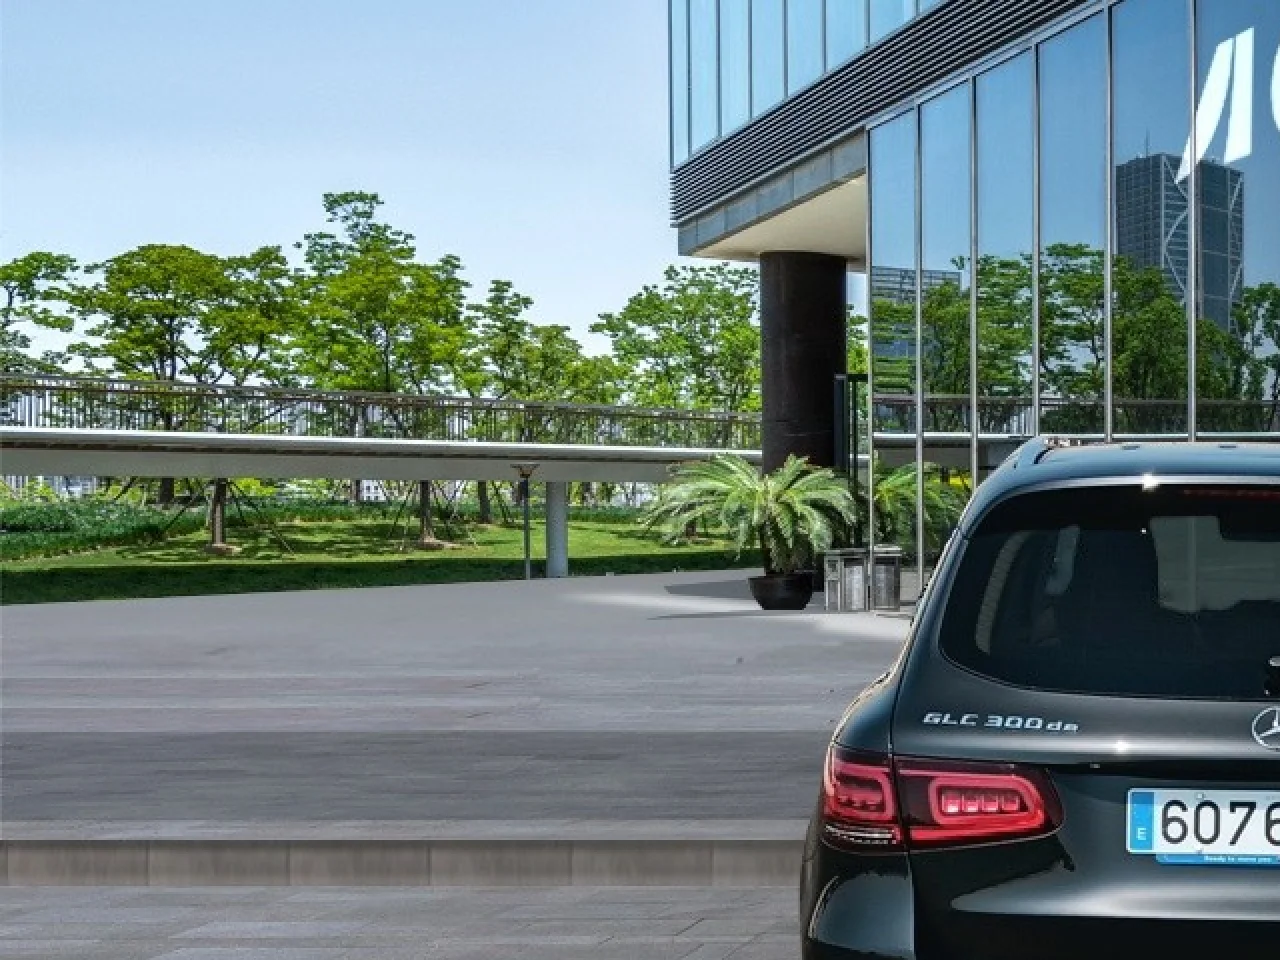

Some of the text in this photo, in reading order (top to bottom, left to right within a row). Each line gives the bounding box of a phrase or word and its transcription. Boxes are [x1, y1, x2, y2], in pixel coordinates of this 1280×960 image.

[923, 712, 978, 726] GLC
[984, 716, 1043, 729] 300
[1136, 827, 1146, 840] E
